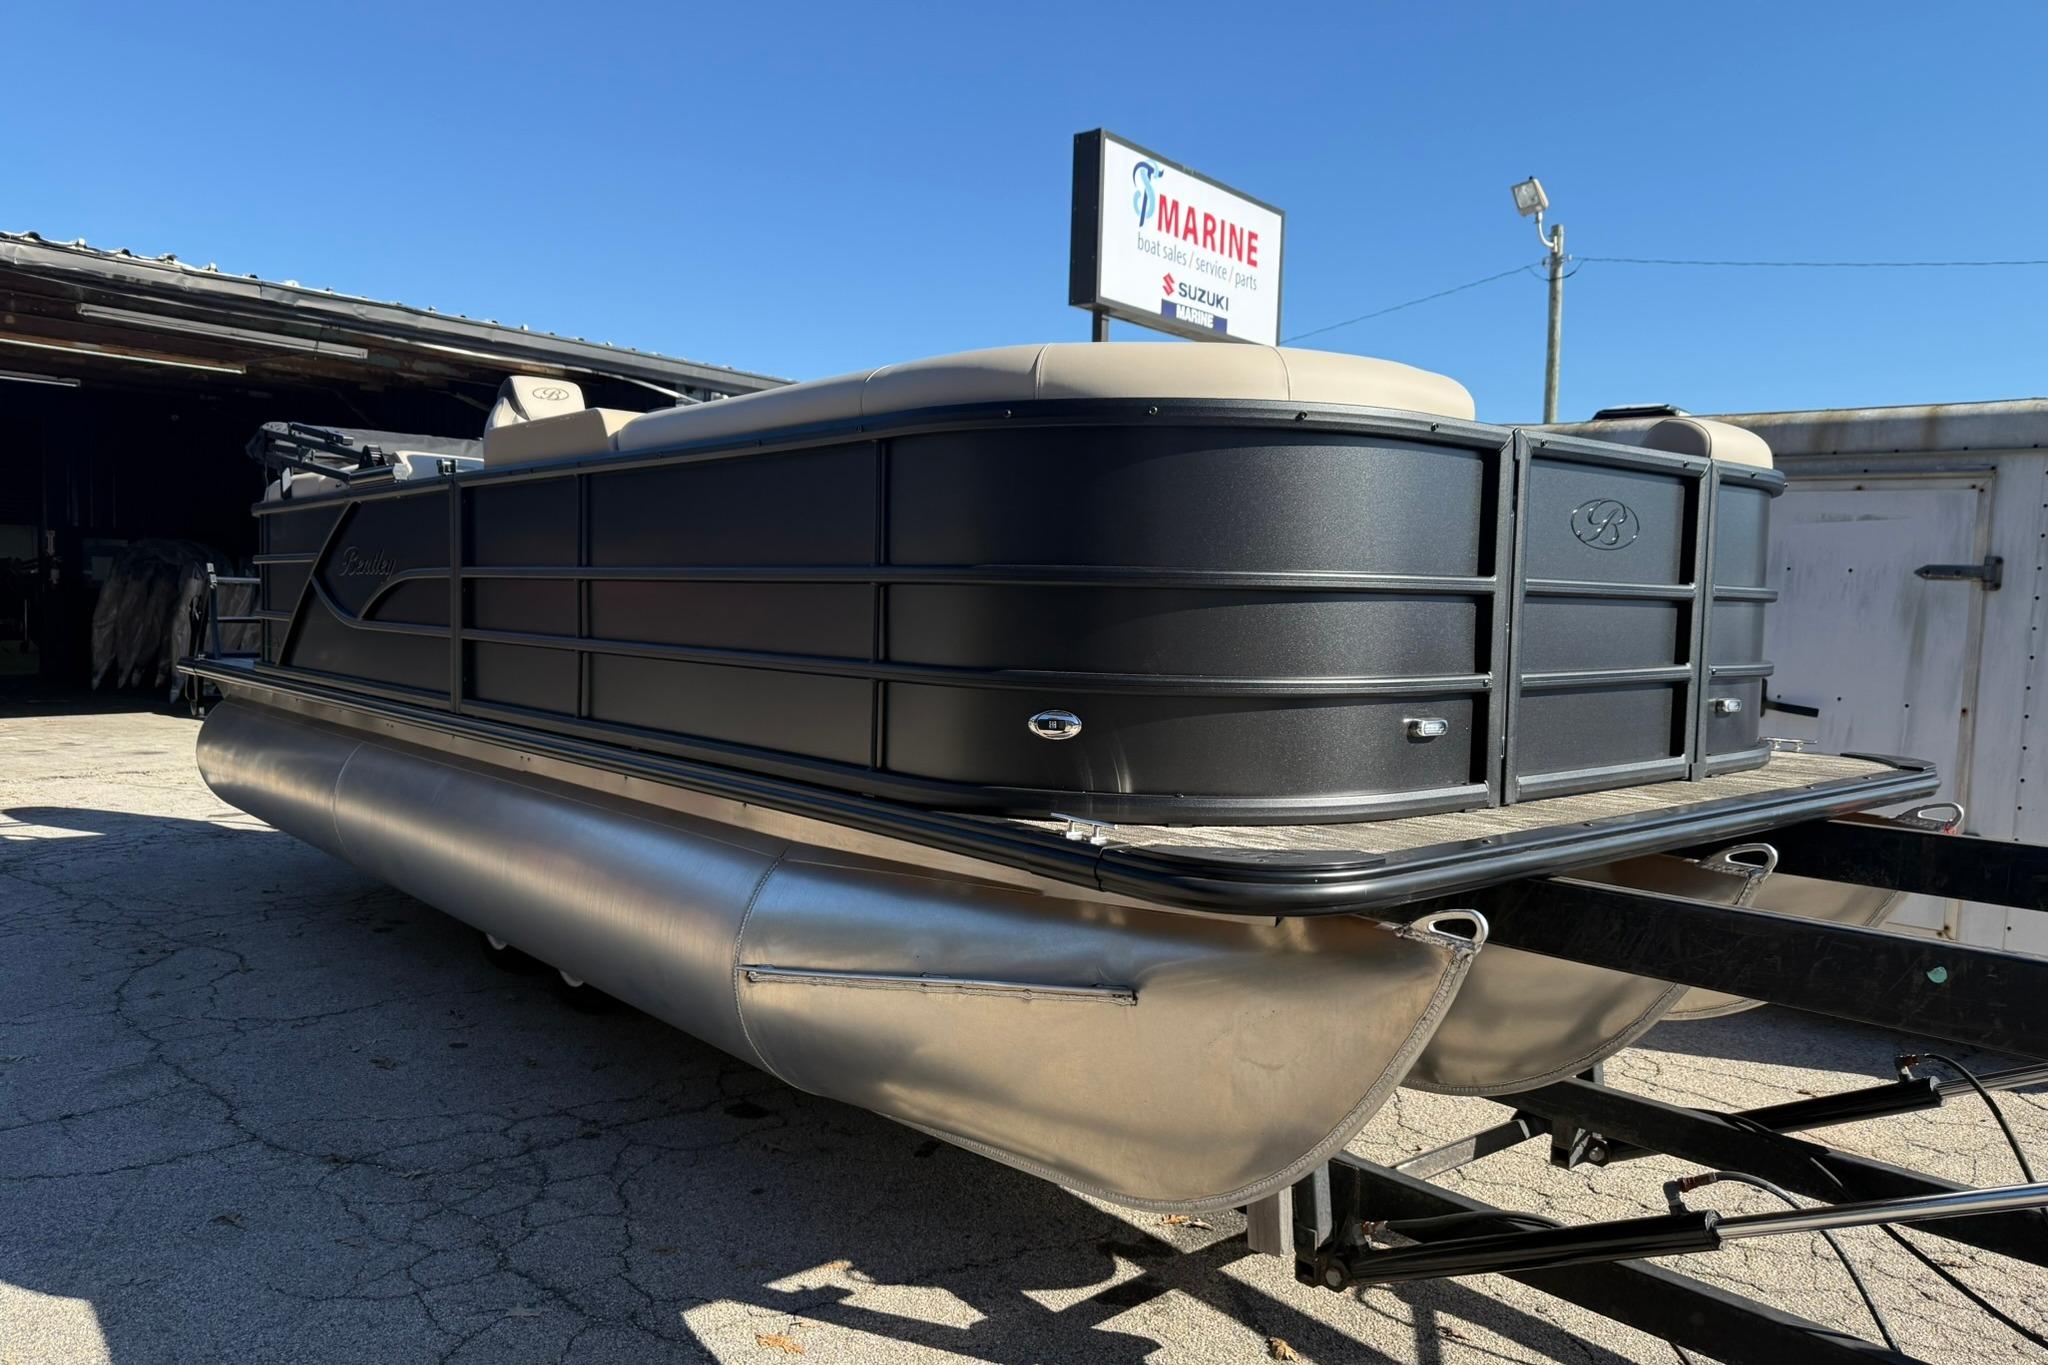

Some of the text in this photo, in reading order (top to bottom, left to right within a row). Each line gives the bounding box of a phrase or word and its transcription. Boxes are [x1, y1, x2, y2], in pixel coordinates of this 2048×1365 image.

[1157, 194, 1259, 268] MARINE
[1137, 231, 1161, 257] boat
[1162, 244, 1187, 267] sales
[1195, 256, 1228, 281] service
[1235, 271, 1257, 291] parts
[1178, 282, 1229, 311] SUZUKI
[1176, 304, 1214, 329] MARINE
[339, 545, 398, 581] Bentley
